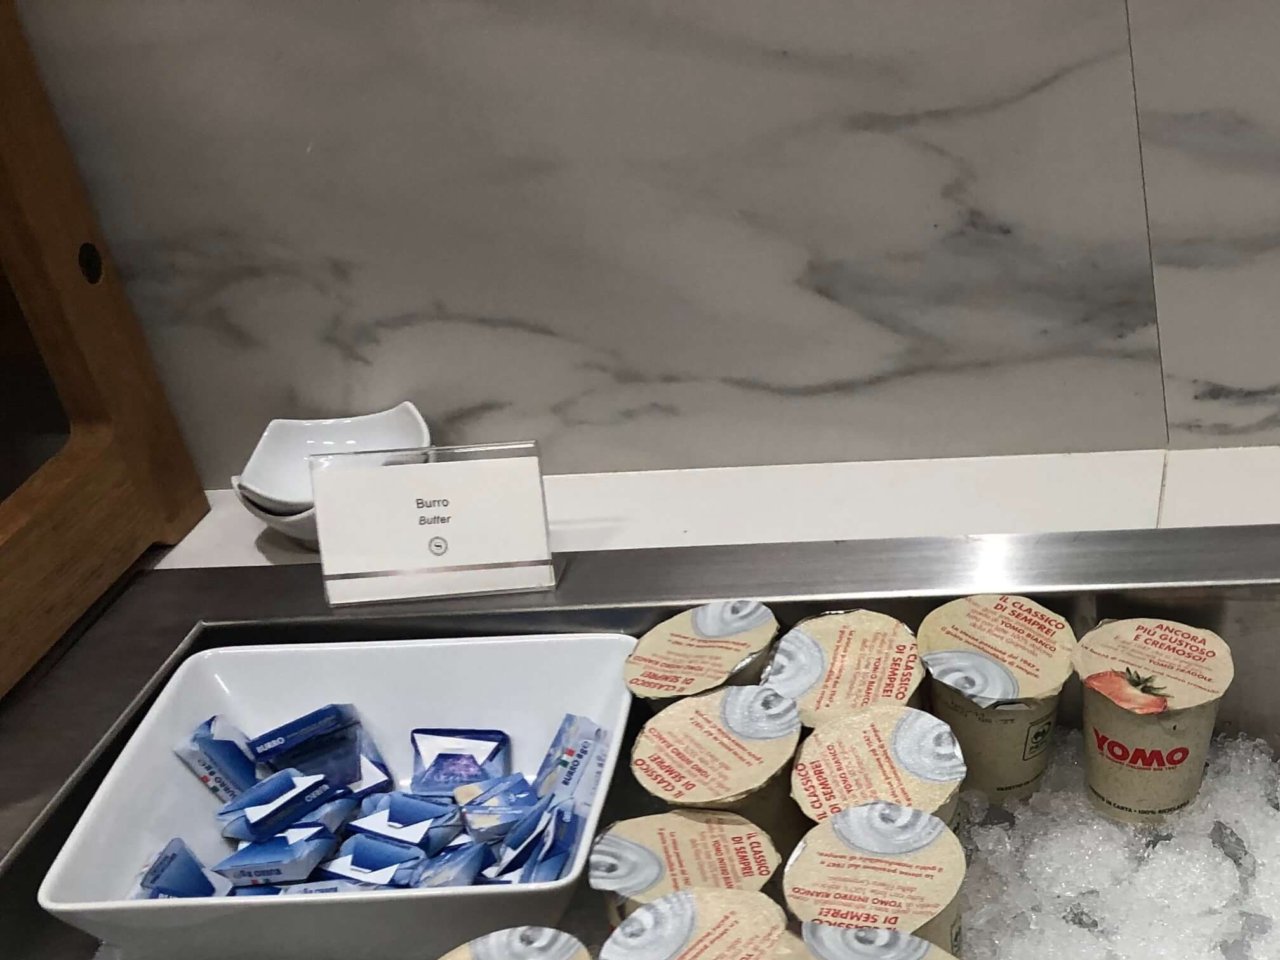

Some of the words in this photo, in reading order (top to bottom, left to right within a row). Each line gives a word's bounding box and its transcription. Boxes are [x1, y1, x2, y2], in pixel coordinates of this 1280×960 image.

[416, 498, 450, 509] Burro
[418, 514, 452, 526] Butter
[993, 603, 1006, 615] DI
[1008, 609, 1056, 637] SEMPRE!
[999, 595, 1009, 603] IL
[1012, 601, 1065, 630] CLASSICO
[1155, 623, 1207, 646] ANCORA
[1159, 632, 1217, 658] GUSTOSO
[895, 644, 906, 654] DI
[1133, 634, 1142, 642] E
[1143, 638, 1207, 663] CREMOSO!
[629, 678, 677, 692] CLASSICO
[640, 672, 681, 684] SEMPRE!
[684, 677, 696, 685] DI
[881, 656, 902, 698] SEMPRE!
[895, 653, 918, 700] CLASSICO
[1093, 727, 1190, 767] YOMO
[562, 760, 580, 786] BURRO
[634, 758, 675, 792] CLASSICO
[649, 754, 685, 783] SEMPRE!
[682, 780, 696, 791] DI
[794, 762, 823, 811] CLASSICO
[810, 760, 837, 803] SEMPRE!
[673, 788, 685, 799] IL
[816, 812, 828, 821] IL
[830, 806, 843, 815] DI
[731, 836, 743, 846] DI
[745, 832, 757, 840] IL
[733, 846, 755, 878] SEMPRE!
[749, 840, 771, 877] CLASSICO
[818, 907, 879, 923] SEMPRE!
[883, 914, 899, 925] DI
